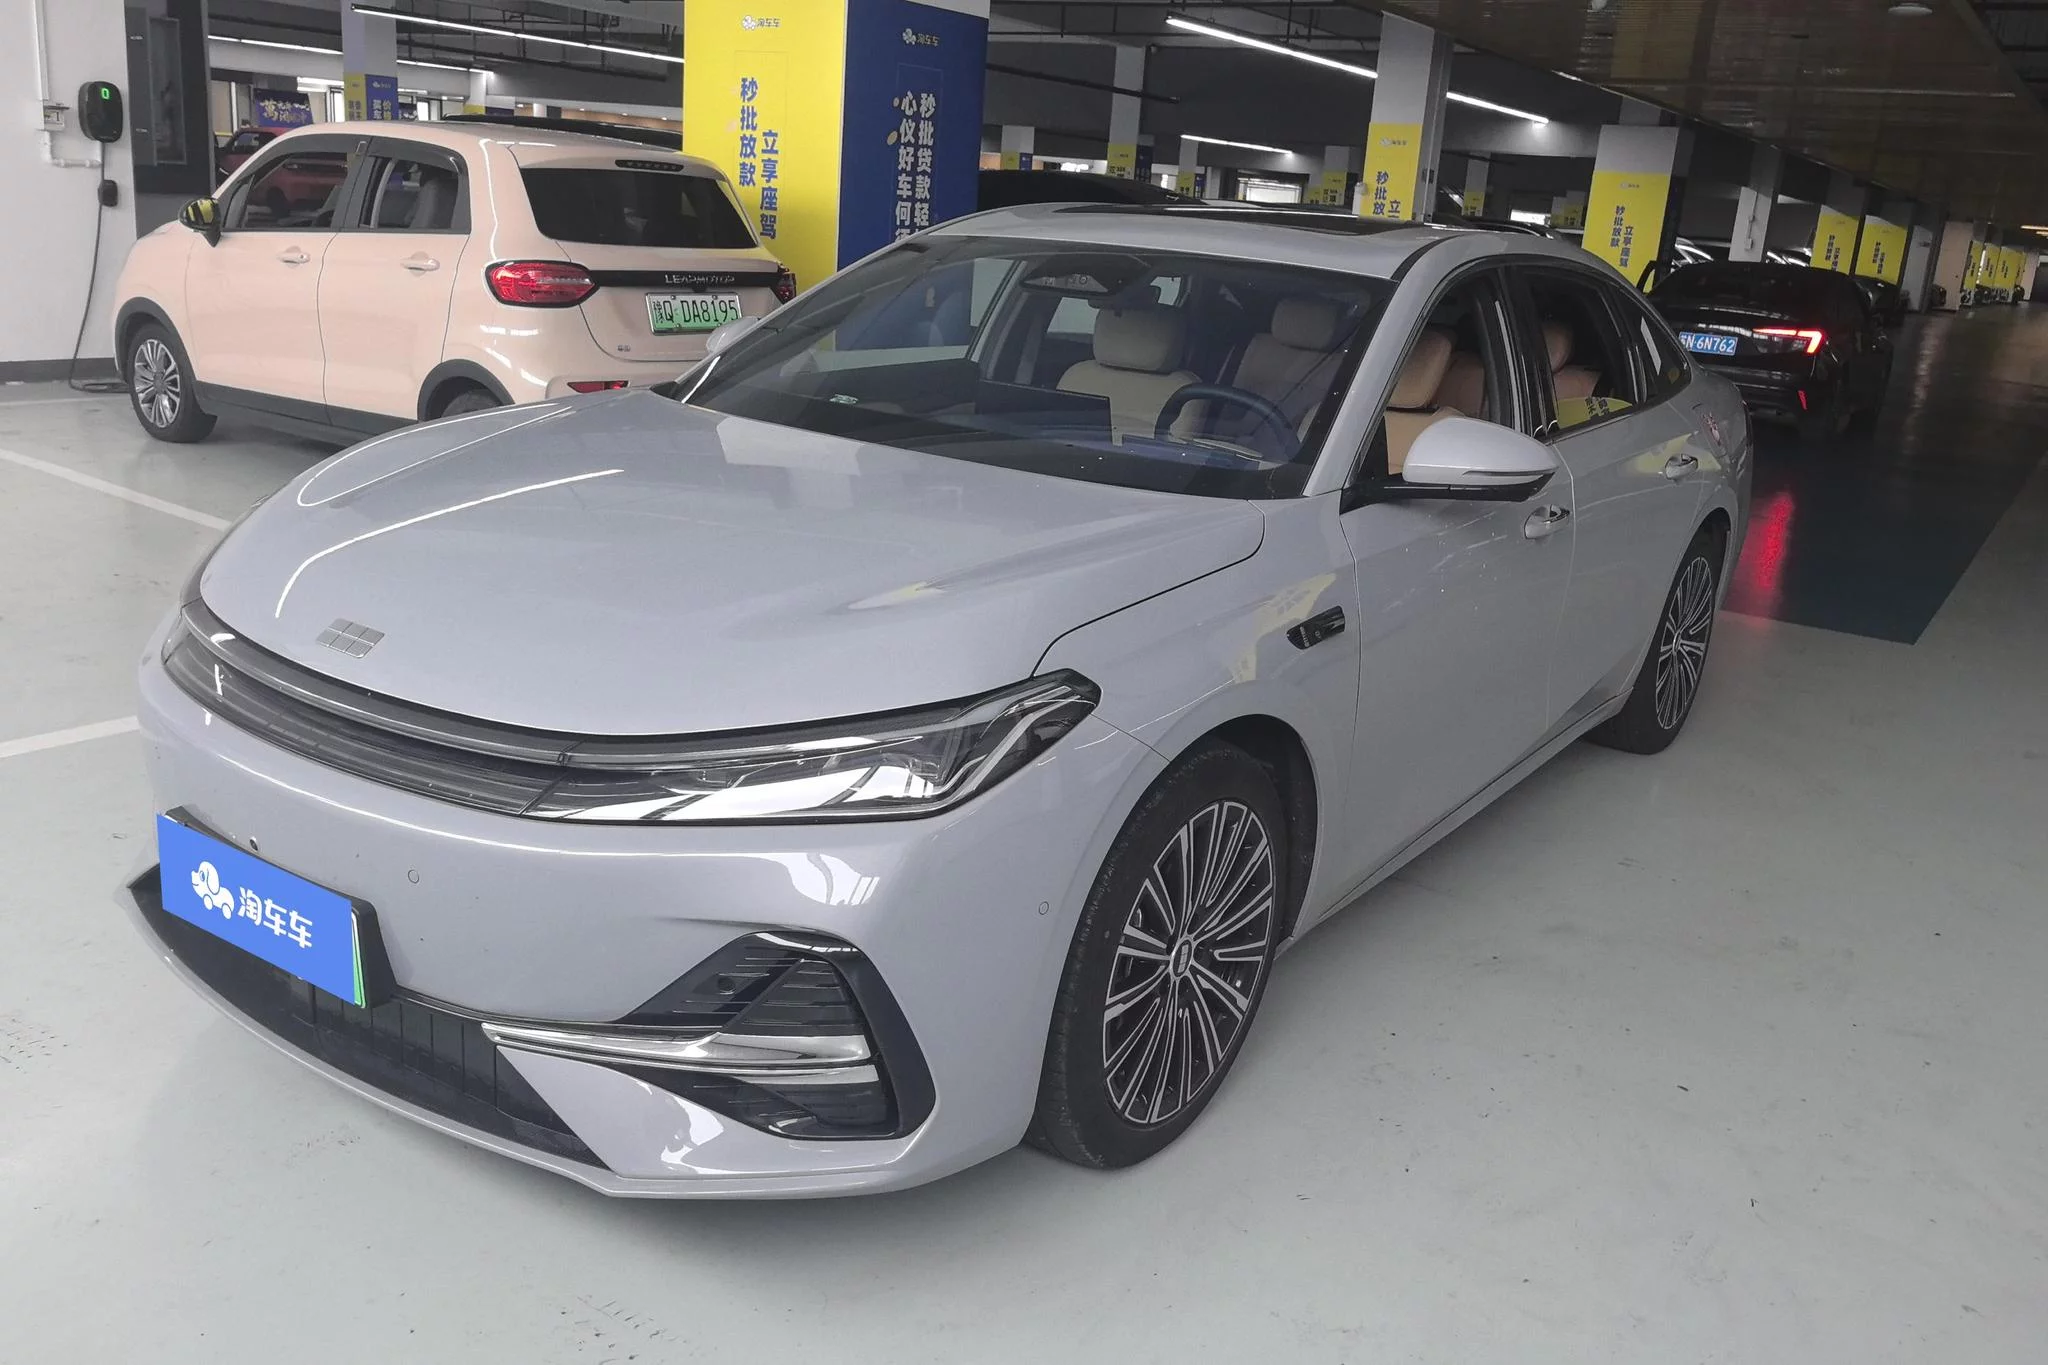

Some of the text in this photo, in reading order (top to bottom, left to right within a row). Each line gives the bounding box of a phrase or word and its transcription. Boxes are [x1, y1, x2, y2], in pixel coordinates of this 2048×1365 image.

[739, 77, 759, 187] 秒批放款
[760, 130, 779, 240] 立享座驾
[914, 92, 937, 232] 秒批贷款轻
